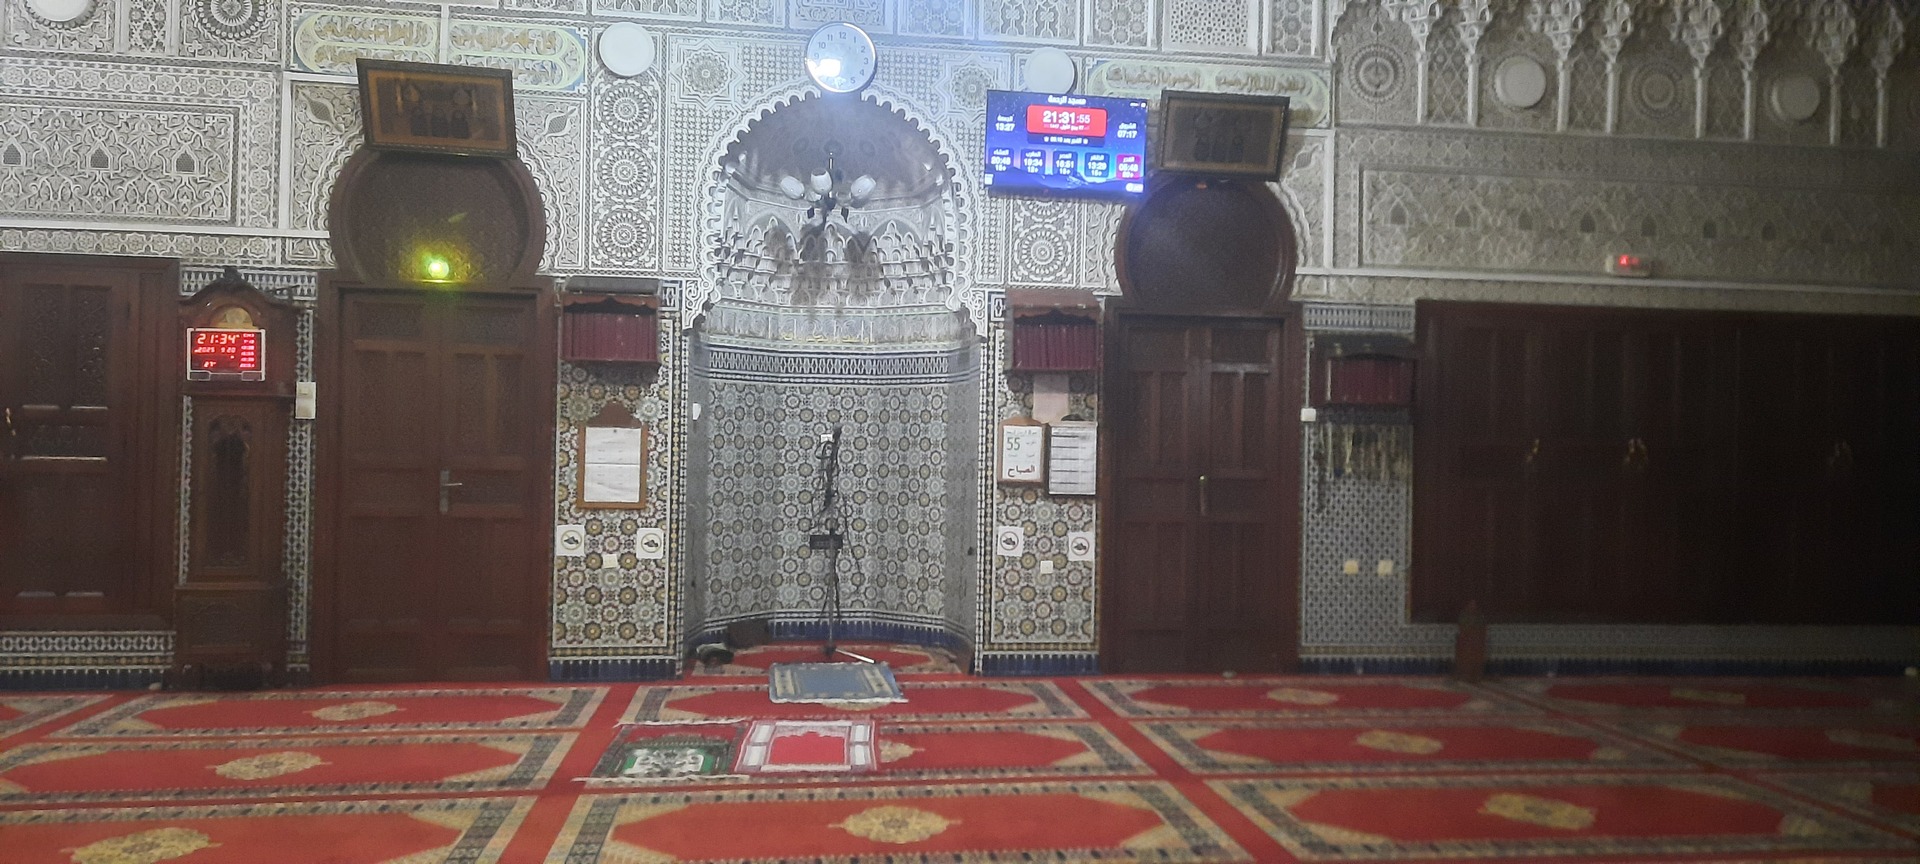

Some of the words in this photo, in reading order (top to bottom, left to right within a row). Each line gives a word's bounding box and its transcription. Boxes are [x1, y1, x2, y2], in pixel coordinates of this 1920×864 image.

[827, 34, 834, 42] 11
[839, 31, 847, 40] 12
[818, 41, 826, 49] 10
[1117, 130, 1137, 138] 07:17
[197, 333, 236, 345] 21:34
[1006, 436, 1020, 450] 55
[1007, 464, 1036, 478] الصباح
